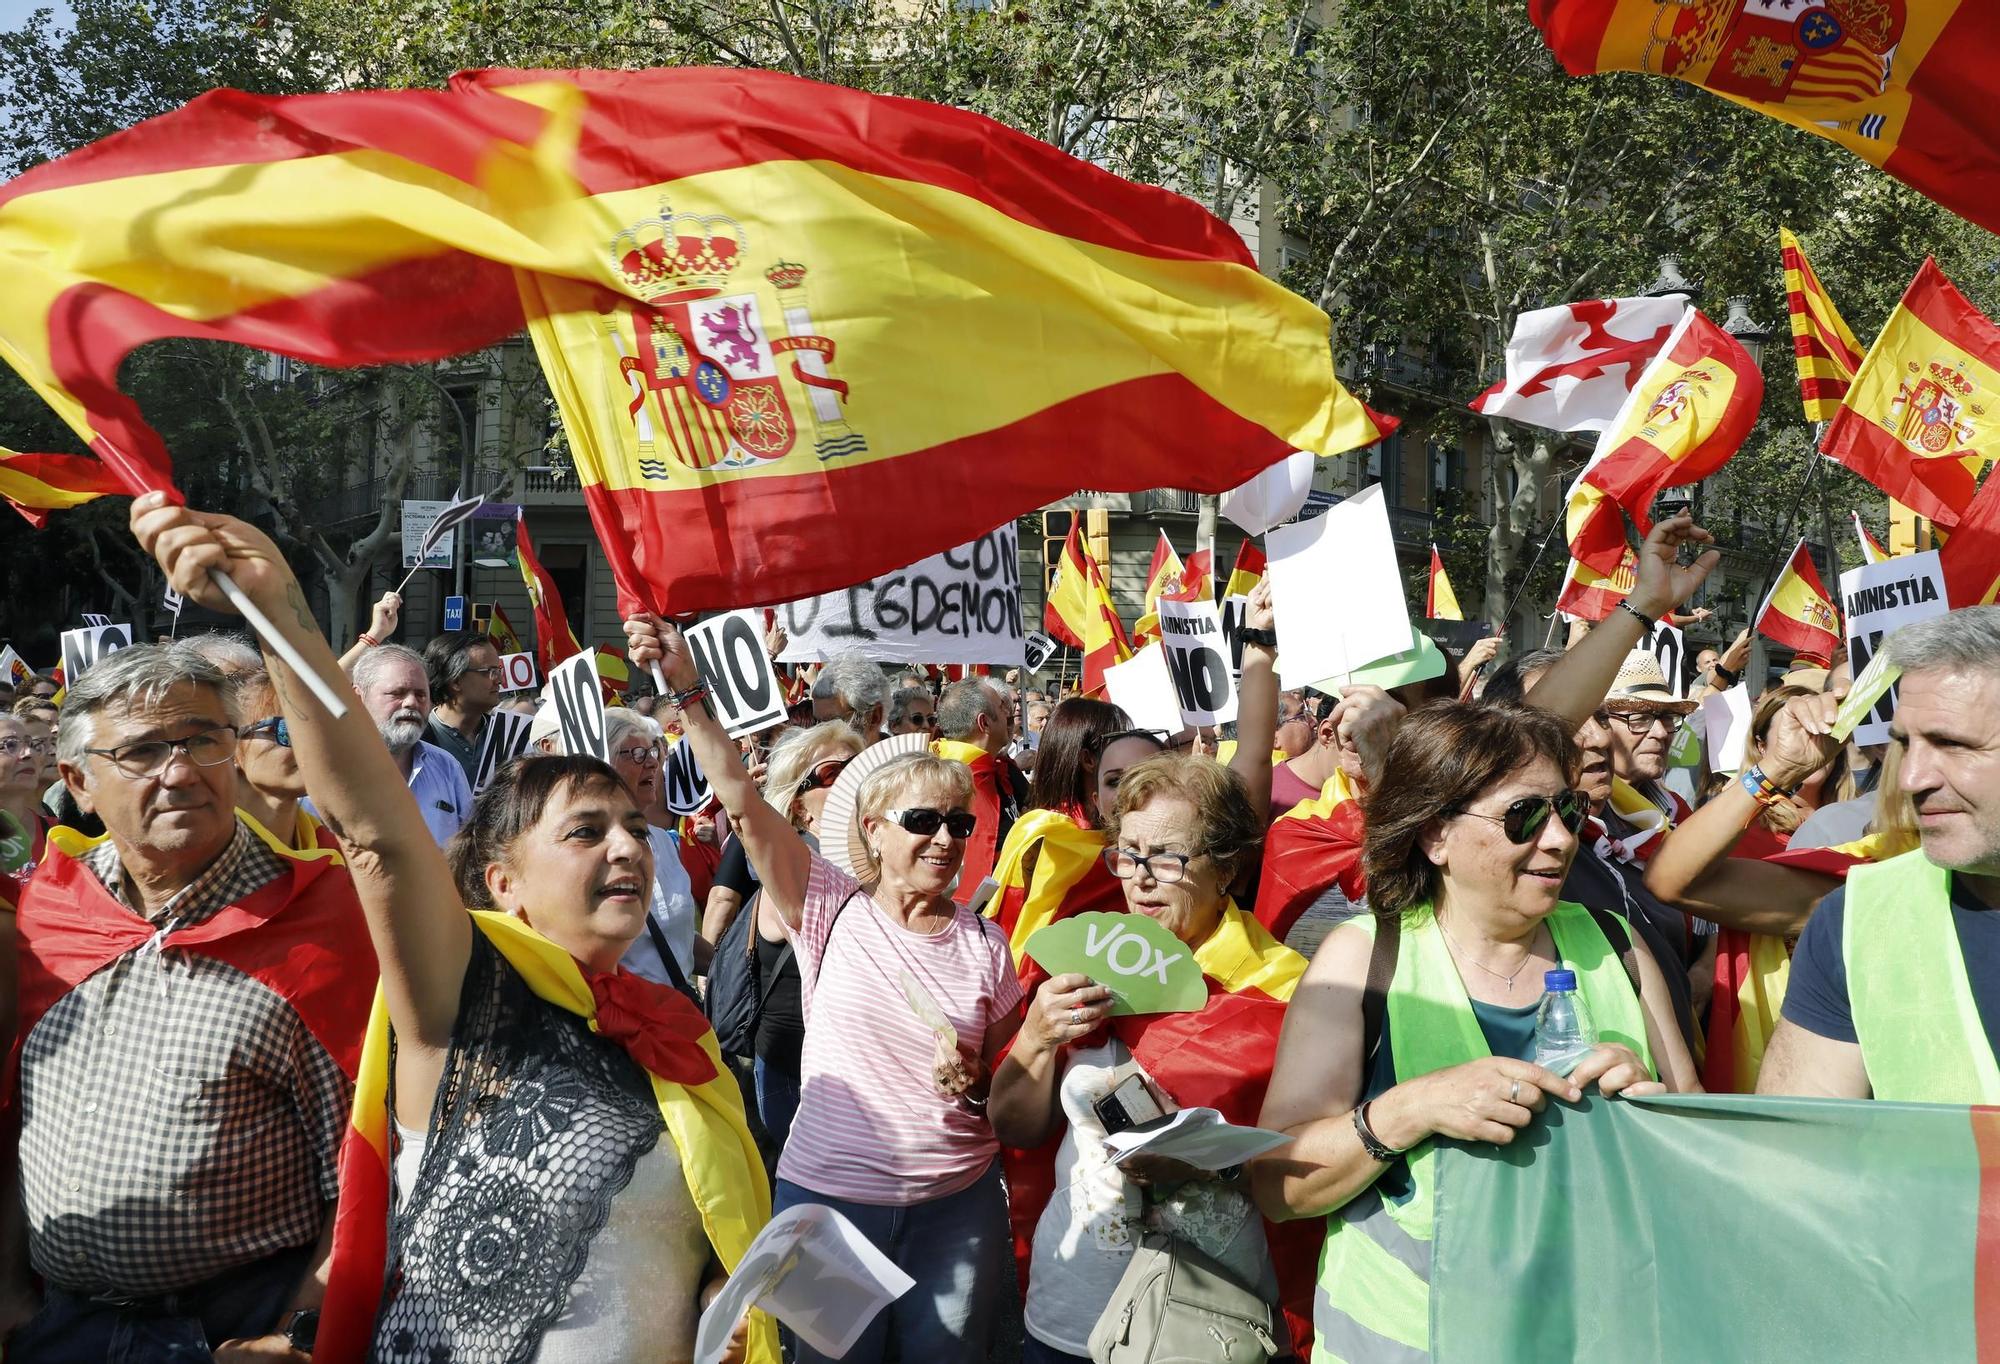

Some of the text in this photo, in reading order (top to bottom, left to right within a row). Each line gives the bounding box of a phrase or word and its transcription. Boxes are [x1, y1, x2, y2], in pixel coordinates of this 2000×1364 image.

[446, 608, 463, 619] TAXI
[1848, 574, 1939, 619] AMNISTÍA
[689, 615, 771, 720] NO
[1025, 642, 1045, 668] NO
[1222, 600, 1247, 670] N
[551, 657, 606, 762] NO
[1165, 644, 1230, 712] NO
[1850, 630, 1900, 727] N
[1085, 922, 1183, 985] VOX
